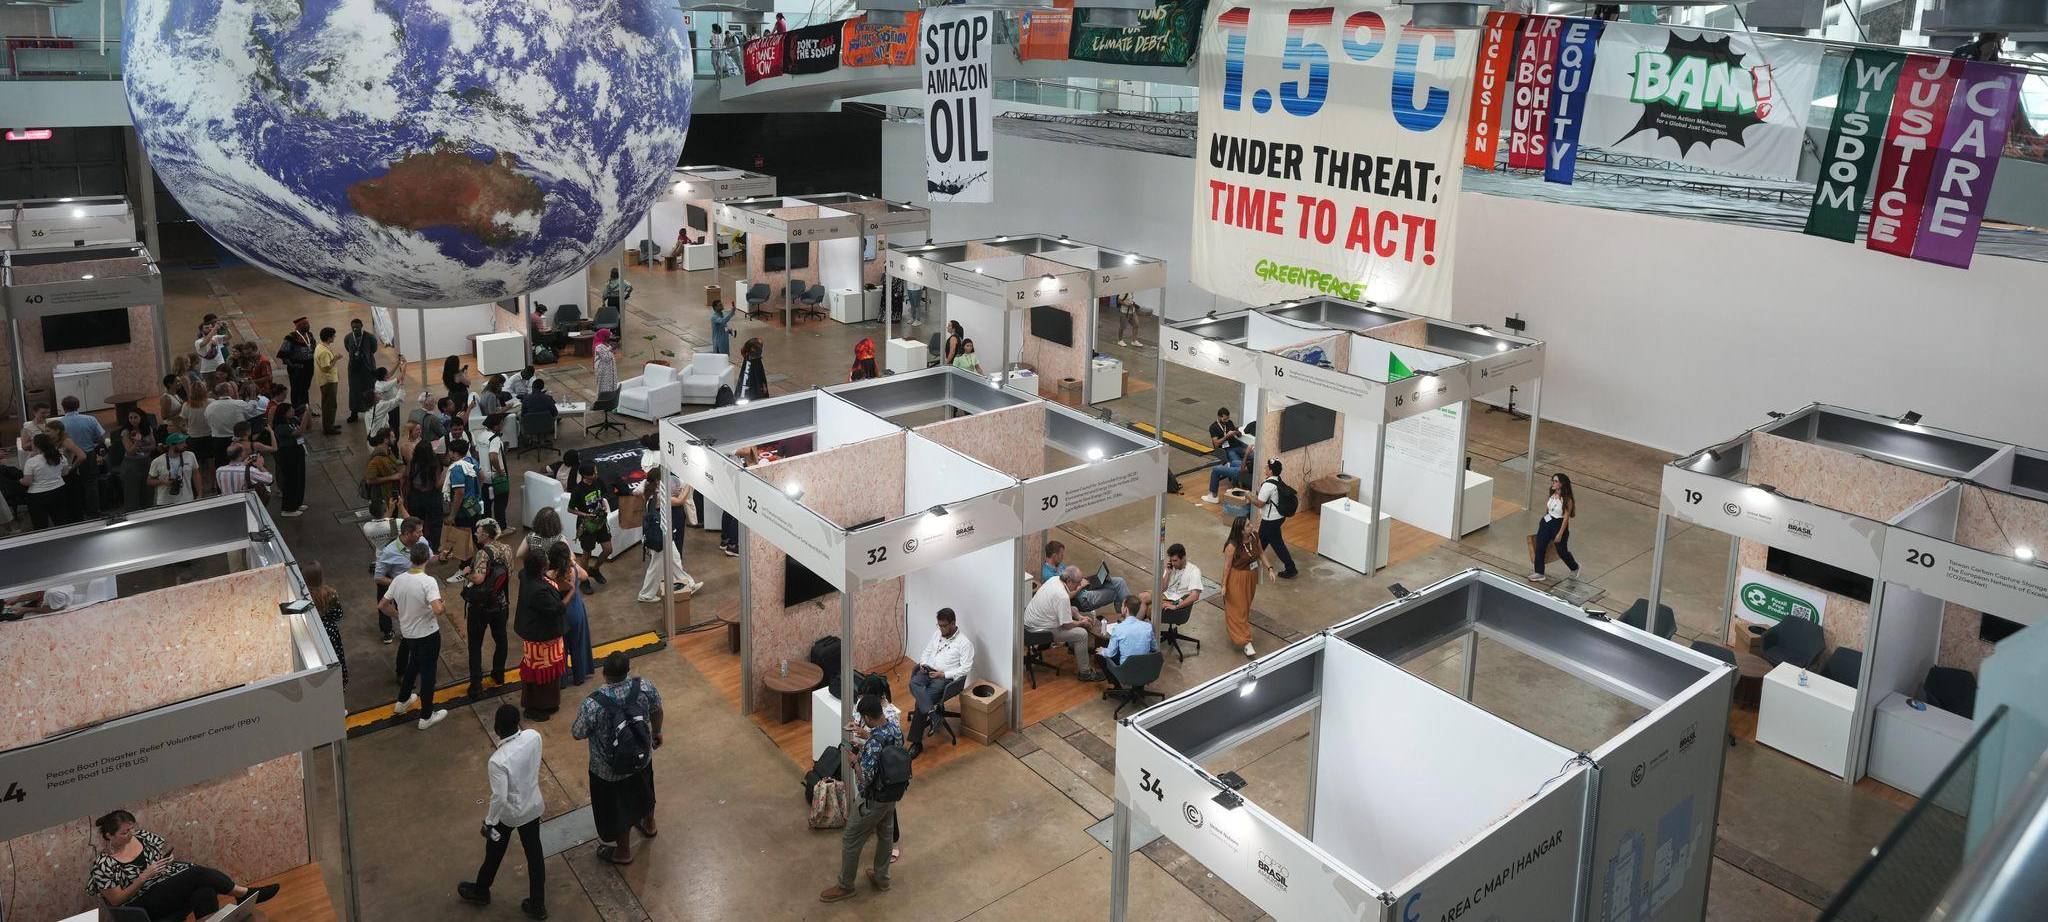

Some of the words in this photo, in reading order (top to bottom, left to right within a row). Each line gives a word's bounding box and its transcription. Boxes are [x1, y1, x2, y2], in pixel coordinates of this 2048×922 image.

[797, 38, 819, 50] DON'T
[925, 15, 988, 65] STOP
[1093, 35, 1132, 52] CLIMATE
[1134, 30, 1171, 53] DEBT!
[797, 50, 810, 60] THE
[810, 44, 836, 59] SOUTH
[928, 63, 988, 96] AMAZON
[1475, 15, 1504, 152] INCLUSION
[1631, 51, 1772, 120] BAM!
[1551, 23, 1590, 170] EQUITY
[930, 96, 988, 164] OIL
[1669, 120, 1688, 129] Global
[1688, 122, 1700, 131] Just
[1702, 125, 1728, 136] Transition
[1677, 113, 1695, 123] Action
[1696, 117, 1727, 129] Mechanism
[1817, 58, 1898, 212] WISDOM
[1871, 58, 1951, 244] JUSTICE
[1929, 80, 2006, 238] CARE
[1210, 132, 1304, 180] UNDER
[1313, 146, 1441, 204] THREAT:
[31, 229, 44, 237] 36
[1210, 180, 1286, 236] TIME
[1297, 194, 1336, 245] TO
[1345, 206, 1437, 266] ACT!
[943, 272, 949, 280] 12
[1102, 275, 1110, 284] 10
[1254, 258, 1367, 301] GREENPEACE
[25, 295, 44, 304] 40
[1016, 292, 1024, 300] 12
[1170, 340, 1179, 350] 15
[1274, 366, 1284, 377] 16
[1481, 368, 1488, 378] 14
[1395, 395, 1404, 406] 16
[668, 441, 674, 456] 31
[748, 496, 758, 514] 32
[1041, 494, 1059, 512] 30
[1684, 488, 1702, 505] 19
[1788, 524, 1813, 536] BRASIL
[867, 546, 887, 566] 32
[1906, 548, 1935, 568] 20
[1950, 560, 1969, 570] Taiwan
[1970, 565, 1994, 577] Carbon
[1994, 572, 2020, 585] Capture
[2021, 579, 2048, 594] Storage
[1960, 569, 1990, 583] European
[1990, 578, 2017, 590] Network
[1772, 598, 1787, 606] Fossil
[46, 768, 75, 780] Peace
[76, 761, 98, 772] Boat
[100, 751, 136, 764] Disaster
[139, 743, 164, 754] Relief
[166, 732, 206, 746] Volunteer
[208, 722, 236, 736] Center
[238, 716, 260, 728] (PBV)
[47, 778, 76, 790] Peace
[77, 770, 100, 781] Boat
[101, 765, 114, 774] US
[115, 760, 132, 770] (PB
[133, 755, 149, 766] US)
[0, 782, 26, 803] 4
[1140, 768, 1164, 802] 34
[1258, 860, 1288, 888] BRASIL
[1440, 897, 1470, 922] AREA
[1473, 888, 1482, 904] C
[1484, 868, 1510, 898] MAP
[1516, 830, 1563, 874] HANGAR
[1402, 892, 1422, 922] C
